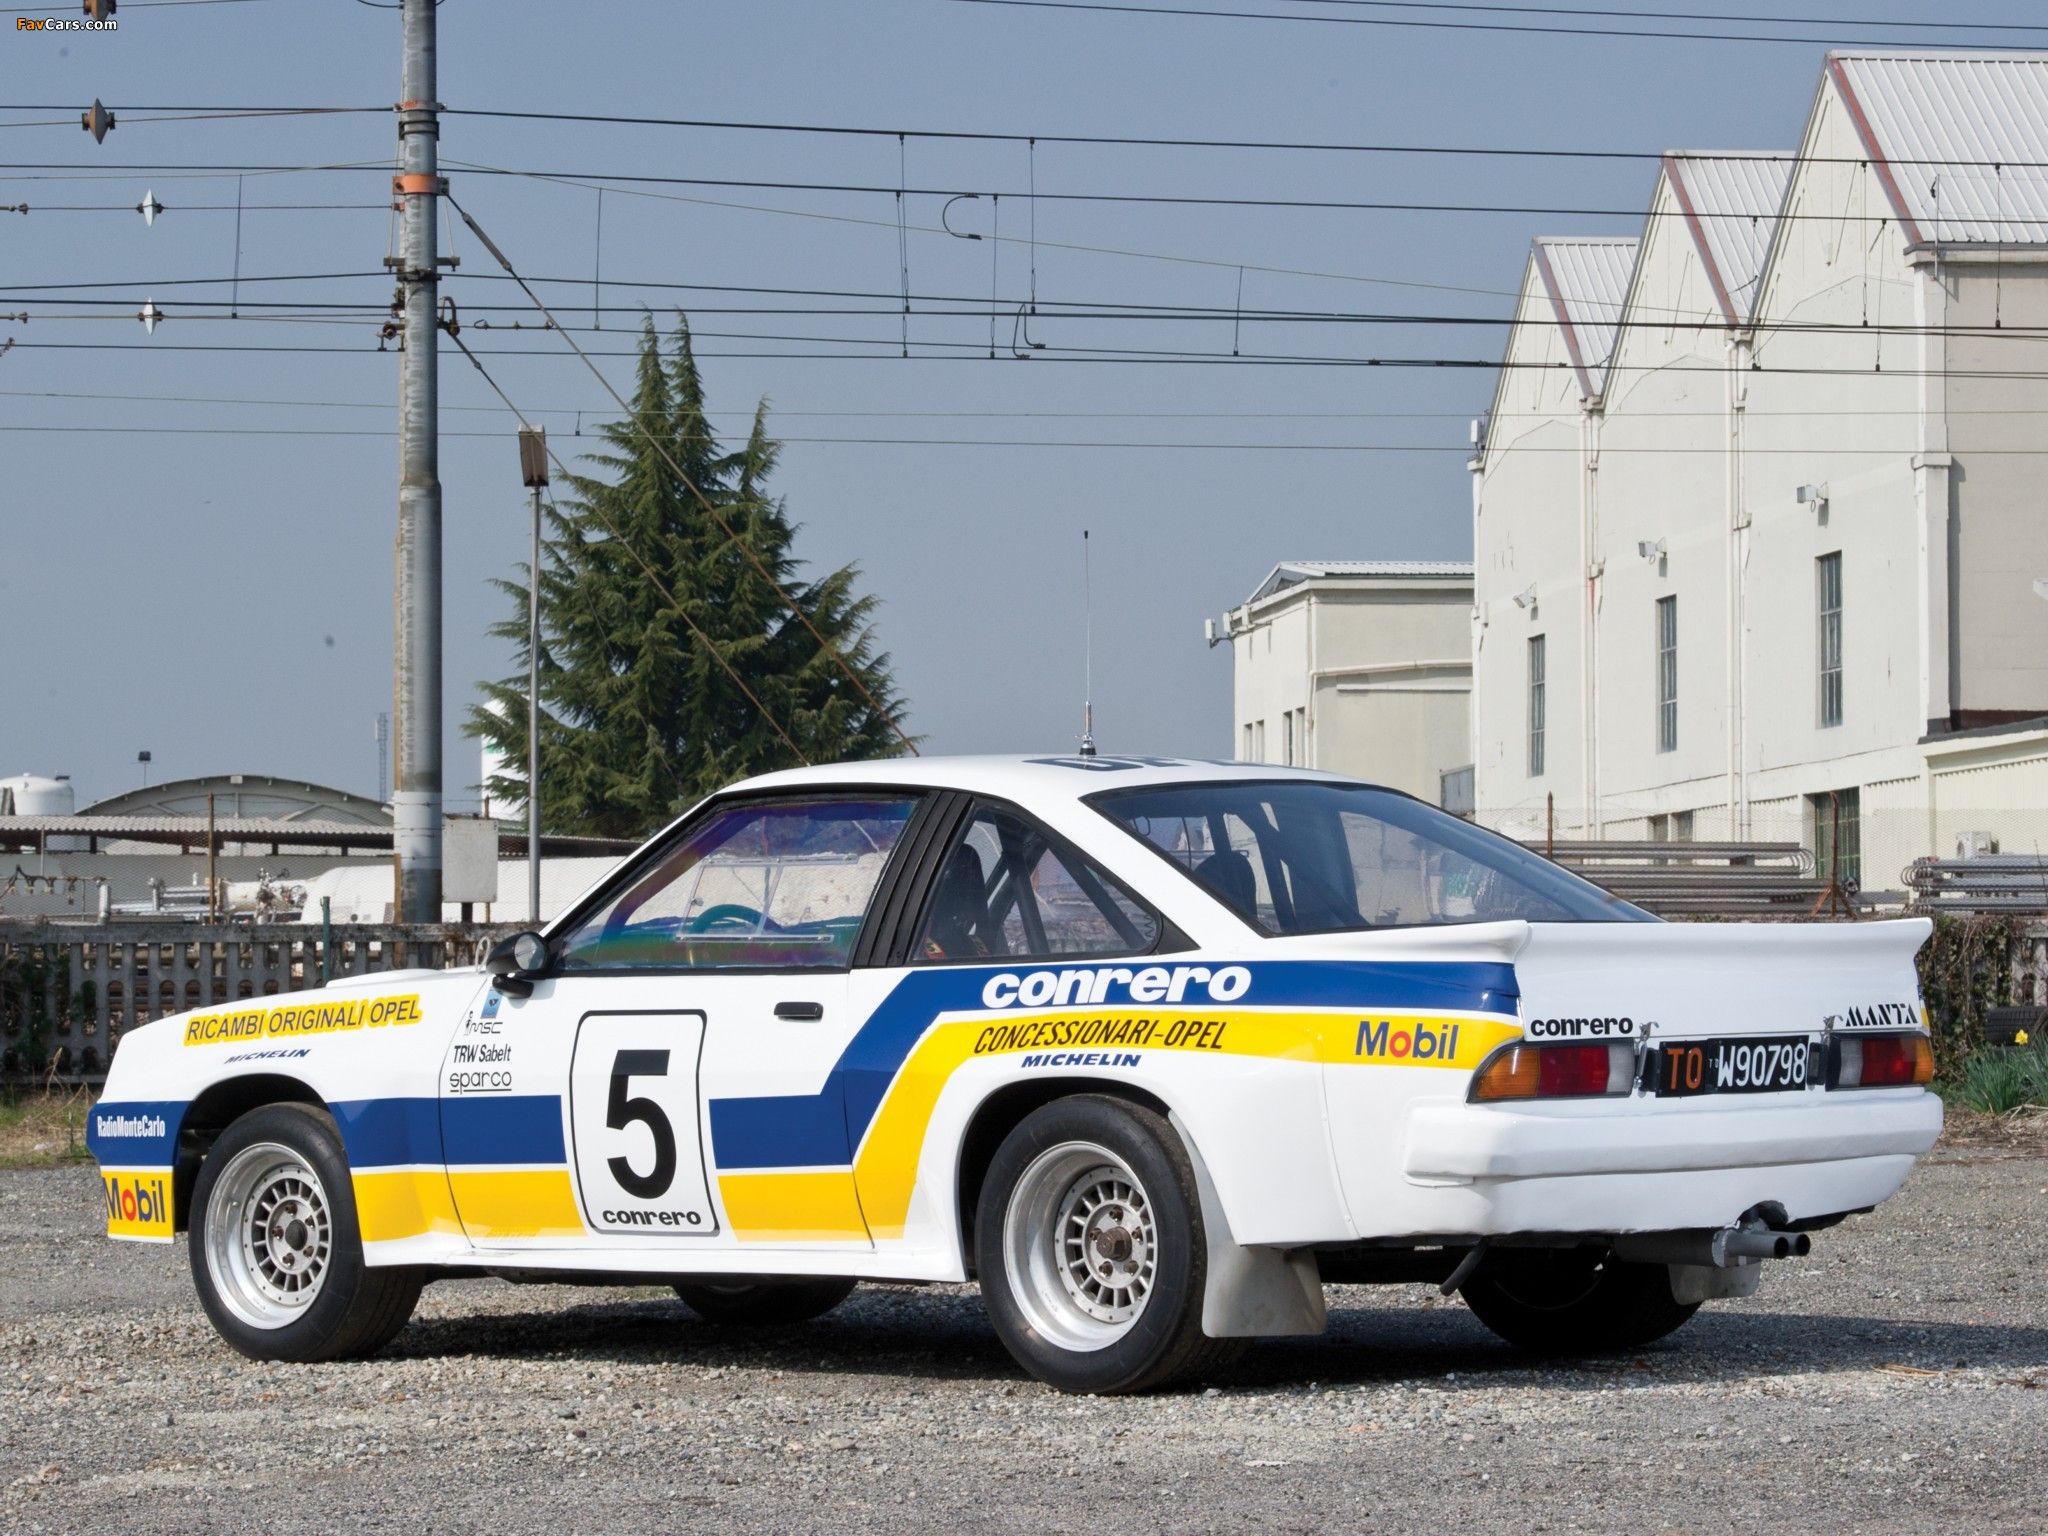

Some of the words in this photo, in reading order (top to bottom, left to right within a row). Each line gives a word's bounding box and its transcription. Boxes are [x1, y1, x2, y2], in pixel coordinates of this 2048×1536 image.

[982, 966, 1252, 1009] conrero
[187, 1015, 263, 1041] RICAMBI
[268, 1004, 365, 1033] ORIGINALI
[370, 999, 419, 1024] OPEL
[1530, 1017, 1633, 1036] conrero
[1845, 1003, 1918, 1027] MANTA
[974, 1019, 1227, 1054] CONCESSIONARI-OPEL
[1355, 1020, 1459, 1060] Mobil
[224, 1049, 312, 1064] MICHELIN
[453, 1044, 478, 1063] TRW
[479, 1043, 512, 1063] Sabelt
[1021, 1054, 1142, 1067] MICHELIN
[1667, 1047, 1703, 1089] TO
[1717, 1042, 1807, 1087] W90798
[449, 1071, 512, 1095] sparco
[97, 1115, 165, 1137] RadioMonteCarlo
[606, 1049, 677, 1200] 5
[102, 1177, 166, 1223] Mobil
[602, 1209, 702, 1225] conrero
